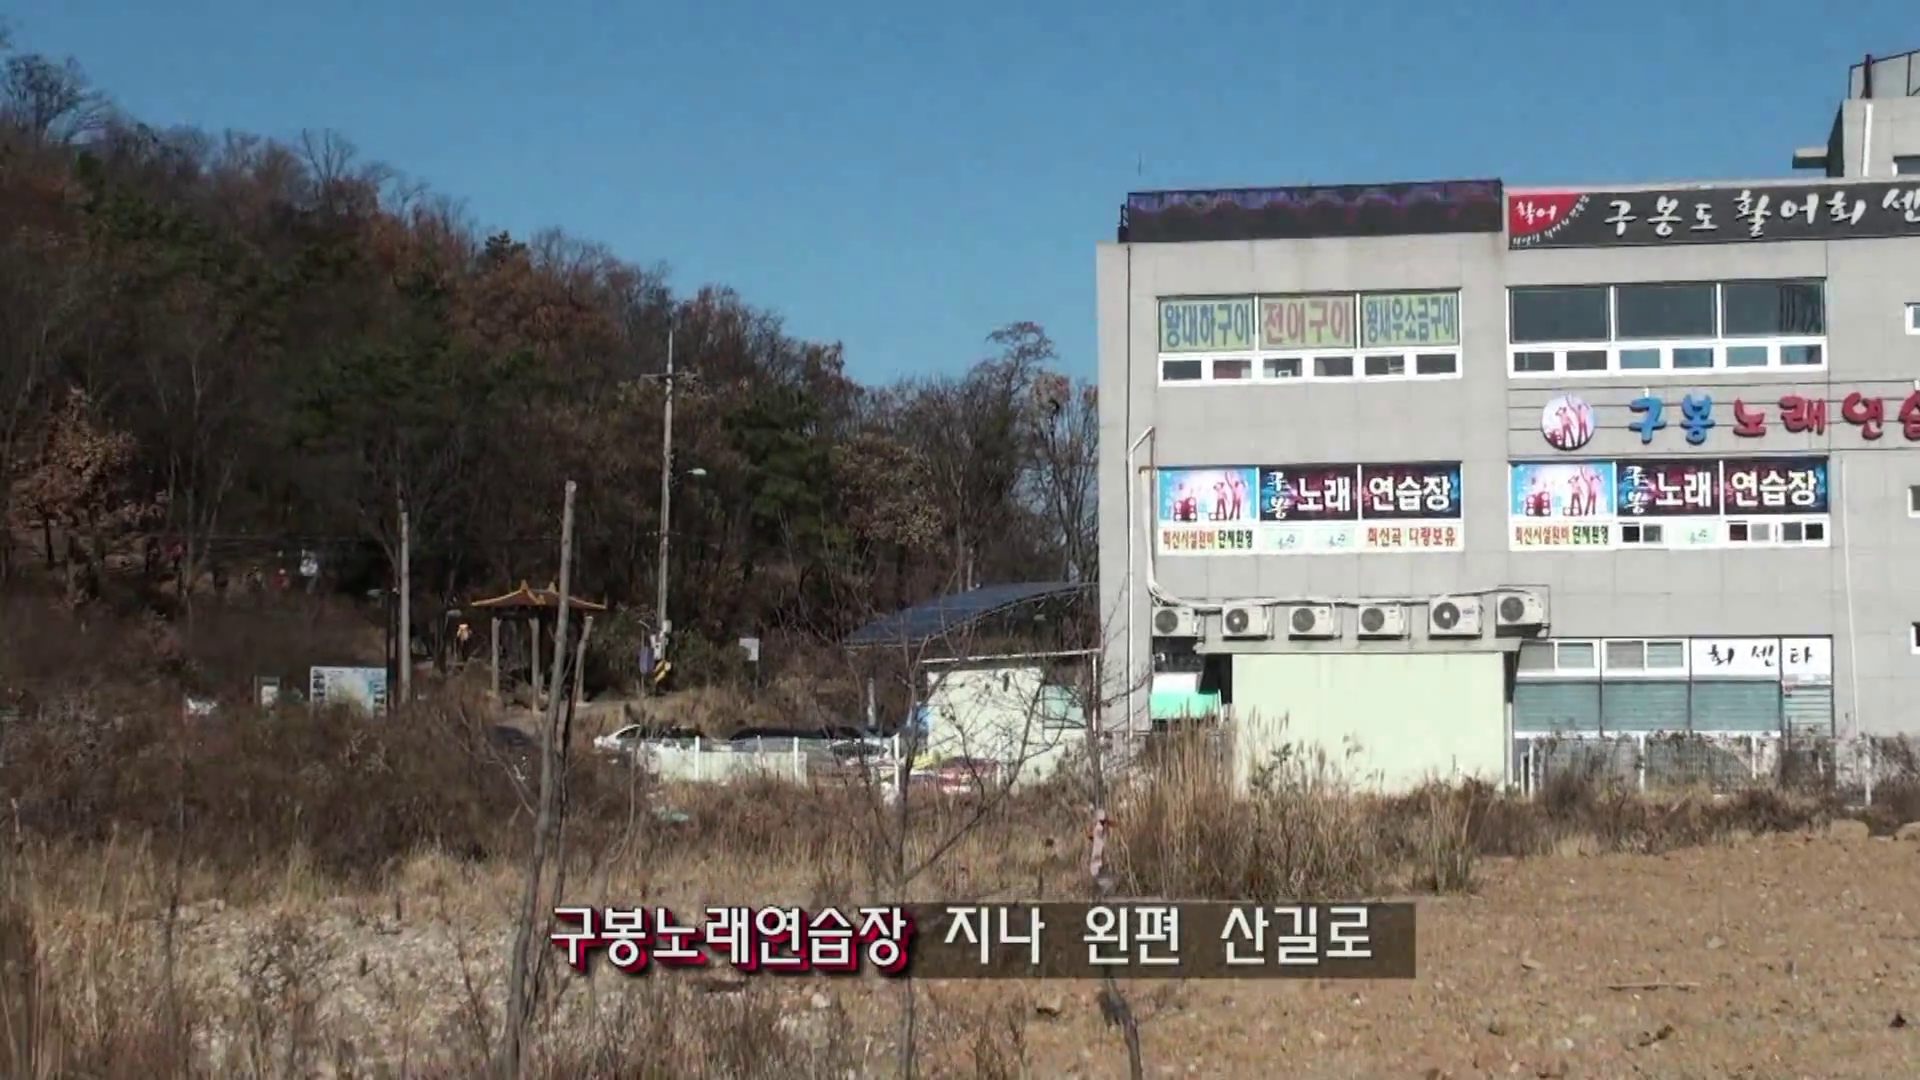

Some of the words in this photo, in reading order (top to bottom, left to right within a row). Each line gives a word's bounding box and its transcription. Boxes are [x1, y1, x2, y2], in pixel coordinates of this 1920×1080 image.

[1164, 303, 1251, 347] 왕대하구이
[1264, 300, 1351, 344] 전어구이
[1366, 296, 1456, 343] 왕새우소금구이
